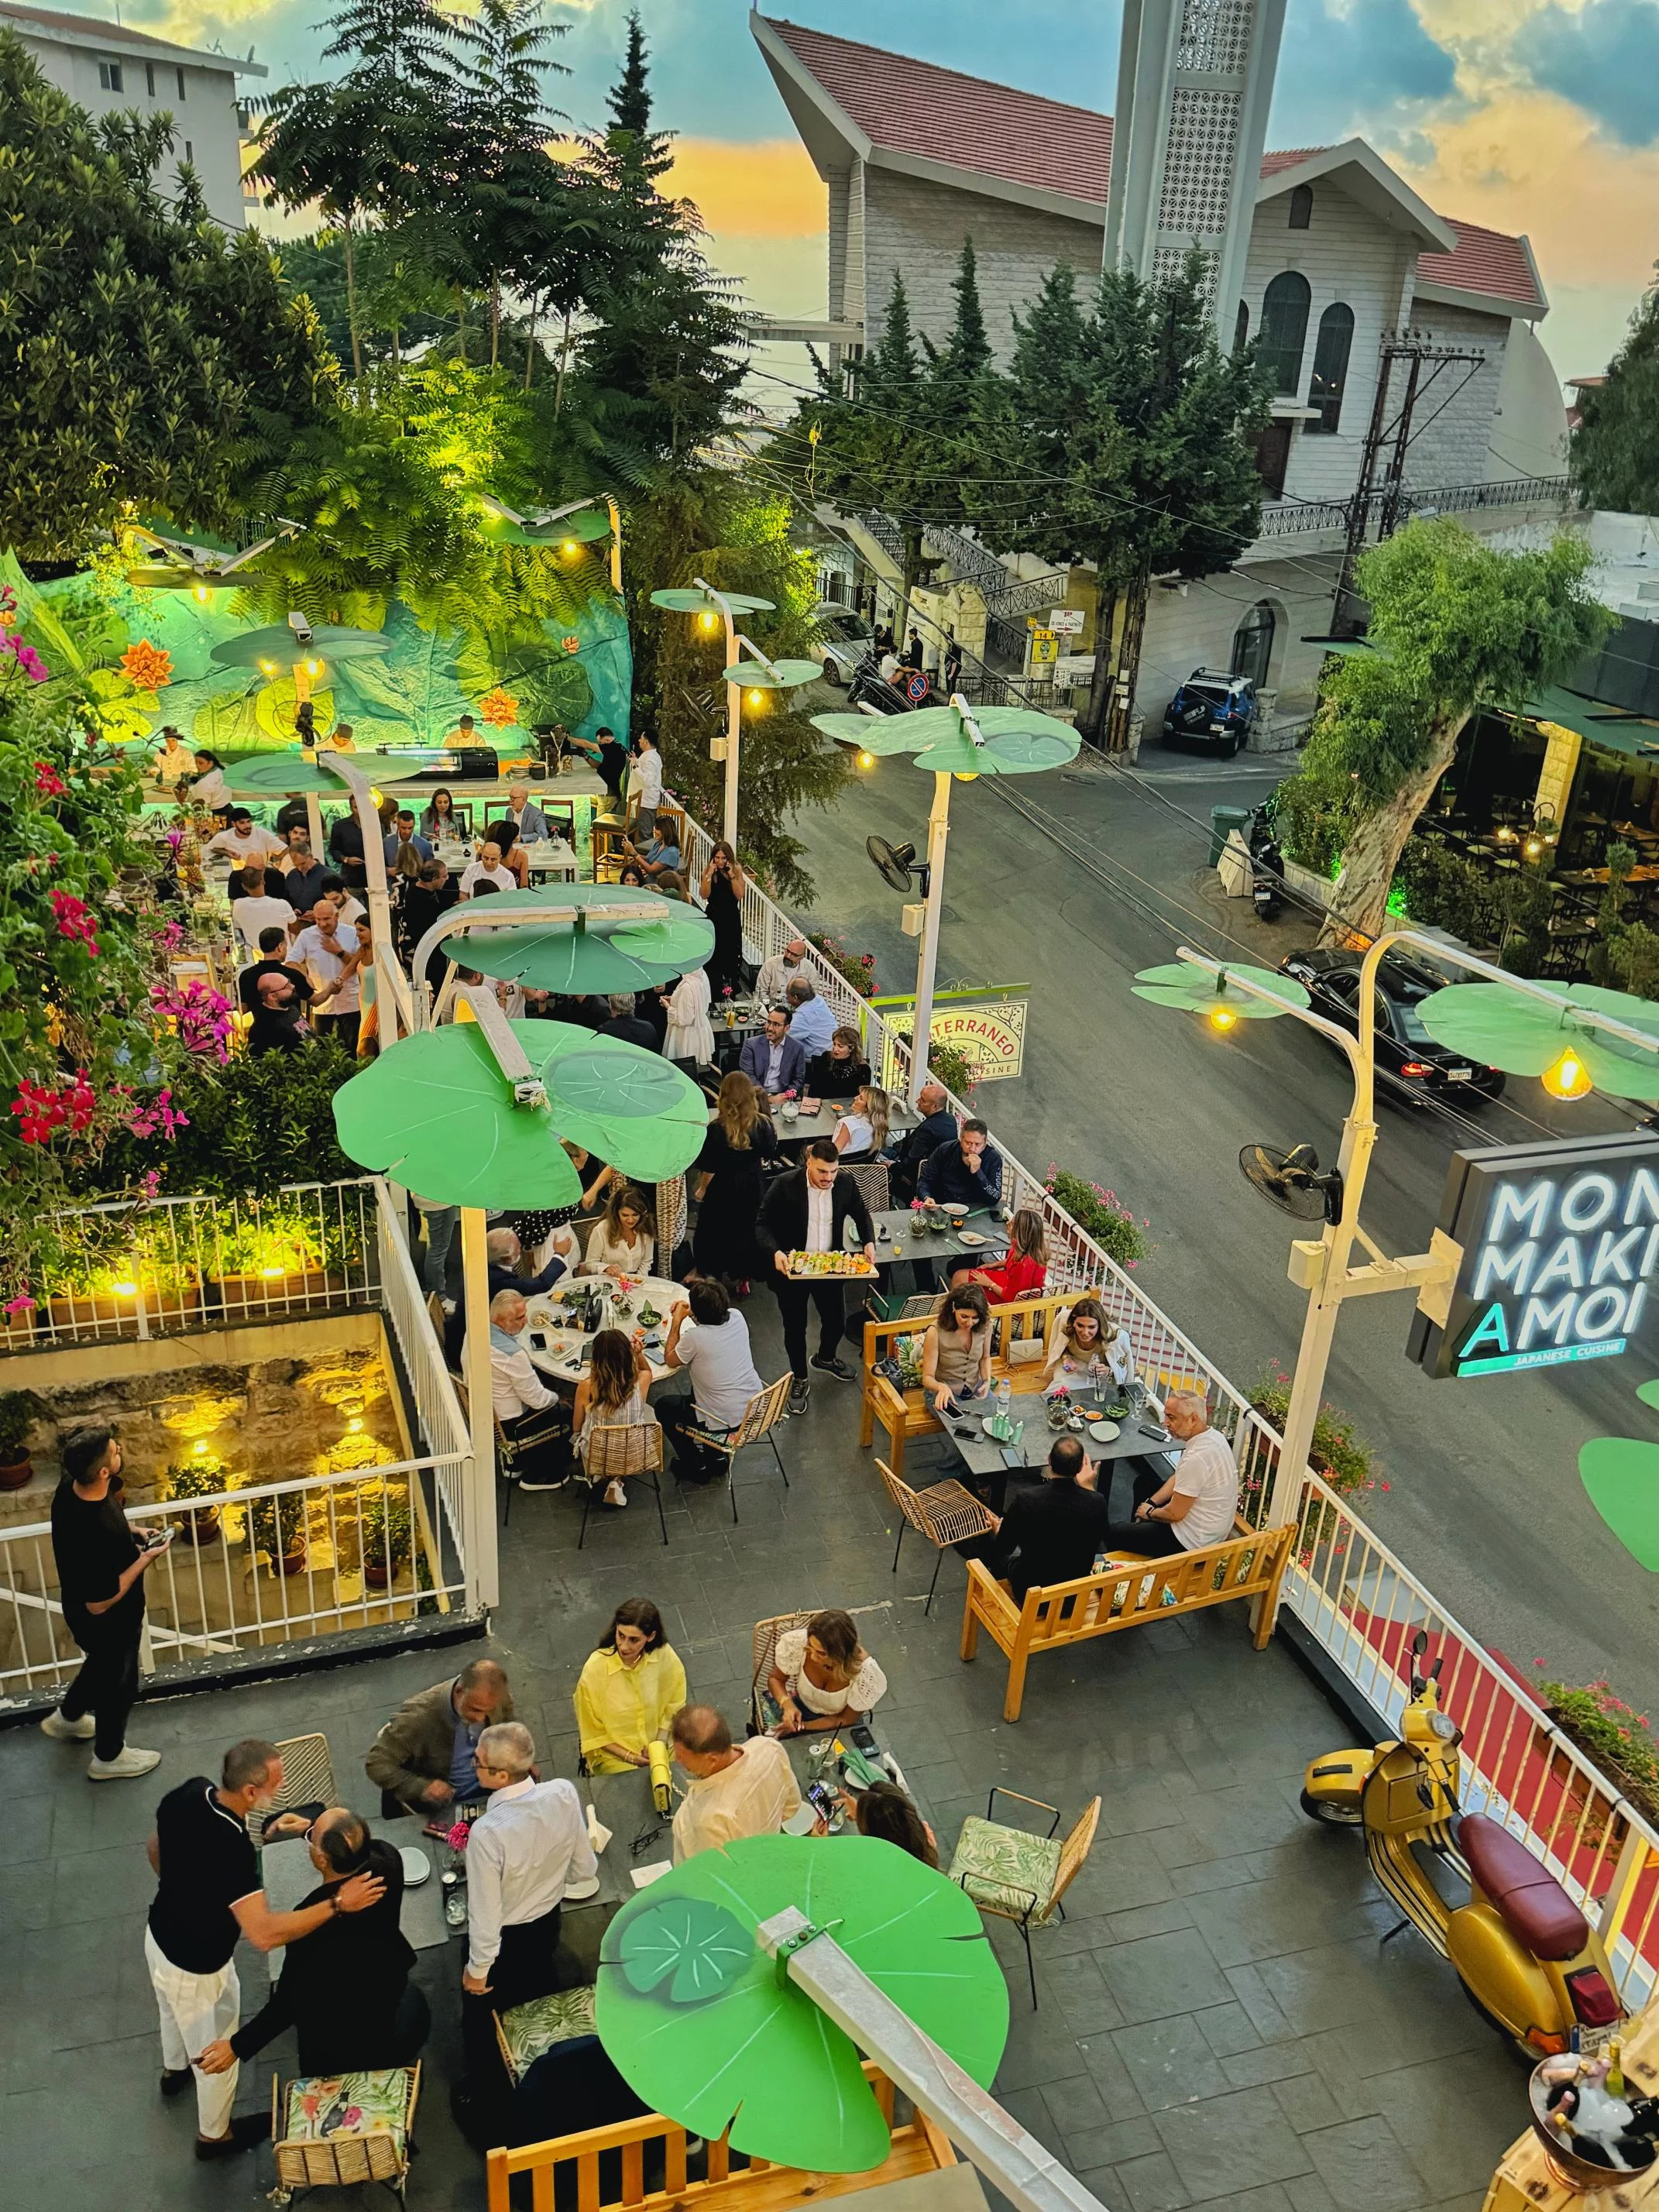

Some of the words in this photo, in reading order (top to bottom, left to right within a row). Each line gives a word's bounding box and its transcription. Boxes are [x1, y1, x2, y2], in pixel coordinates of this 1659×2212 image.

[929, 1019, 1015, 1056] TERRANEO
[1513, 1348, 1571, 1366] JAPANESE
[1576, 1342, 1622, 1357] CUISINE
